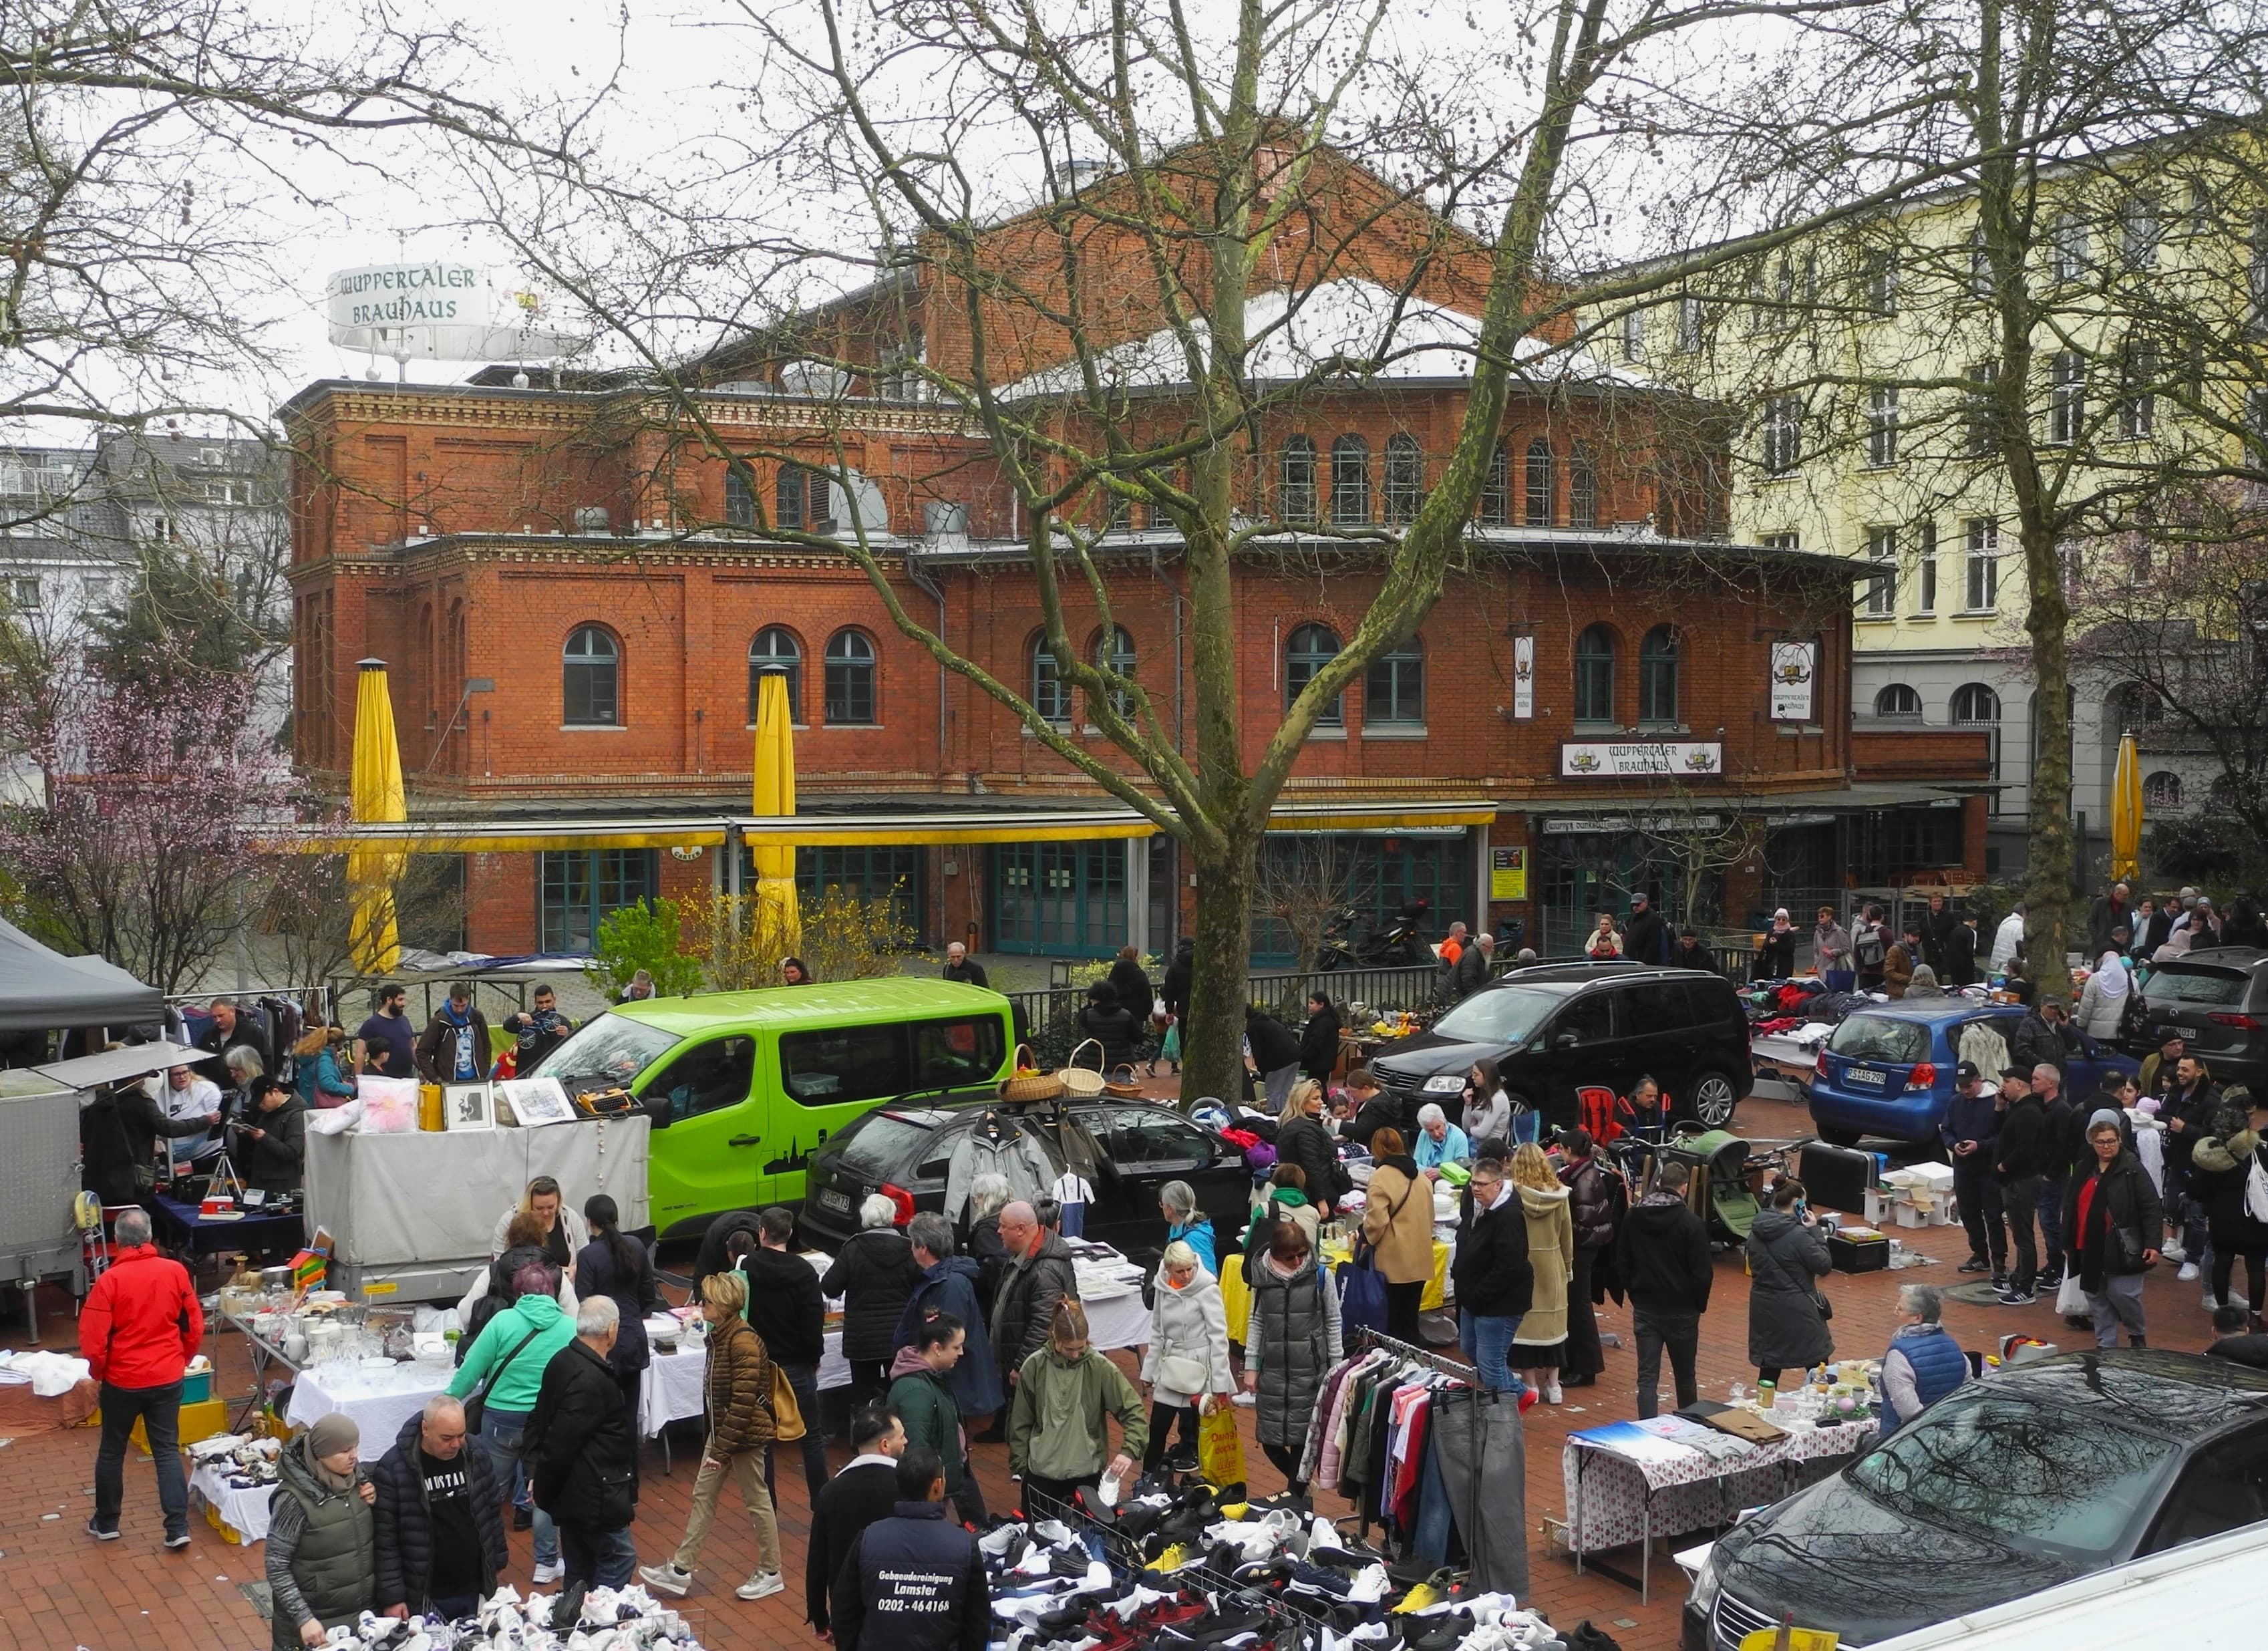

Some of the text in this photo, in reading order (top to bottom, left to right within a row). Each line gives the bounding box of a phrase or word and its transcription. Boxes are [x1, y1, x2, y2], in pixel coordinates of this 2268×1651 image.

[341, 265, 477, 296] WUPPERTALER
[1779, 702, 1804, 710] AUHAUS
[1609, 745, 1677, 757] WUPPERTALER
[1619, 758, 1669, 772] BRAUHAUS
[1848, 1068, 1885, 1083] RS AG 298
[878, 1570, 953, 1585] Gebaeudereinigung
[894, 1582, 937, 1596] Lamster
